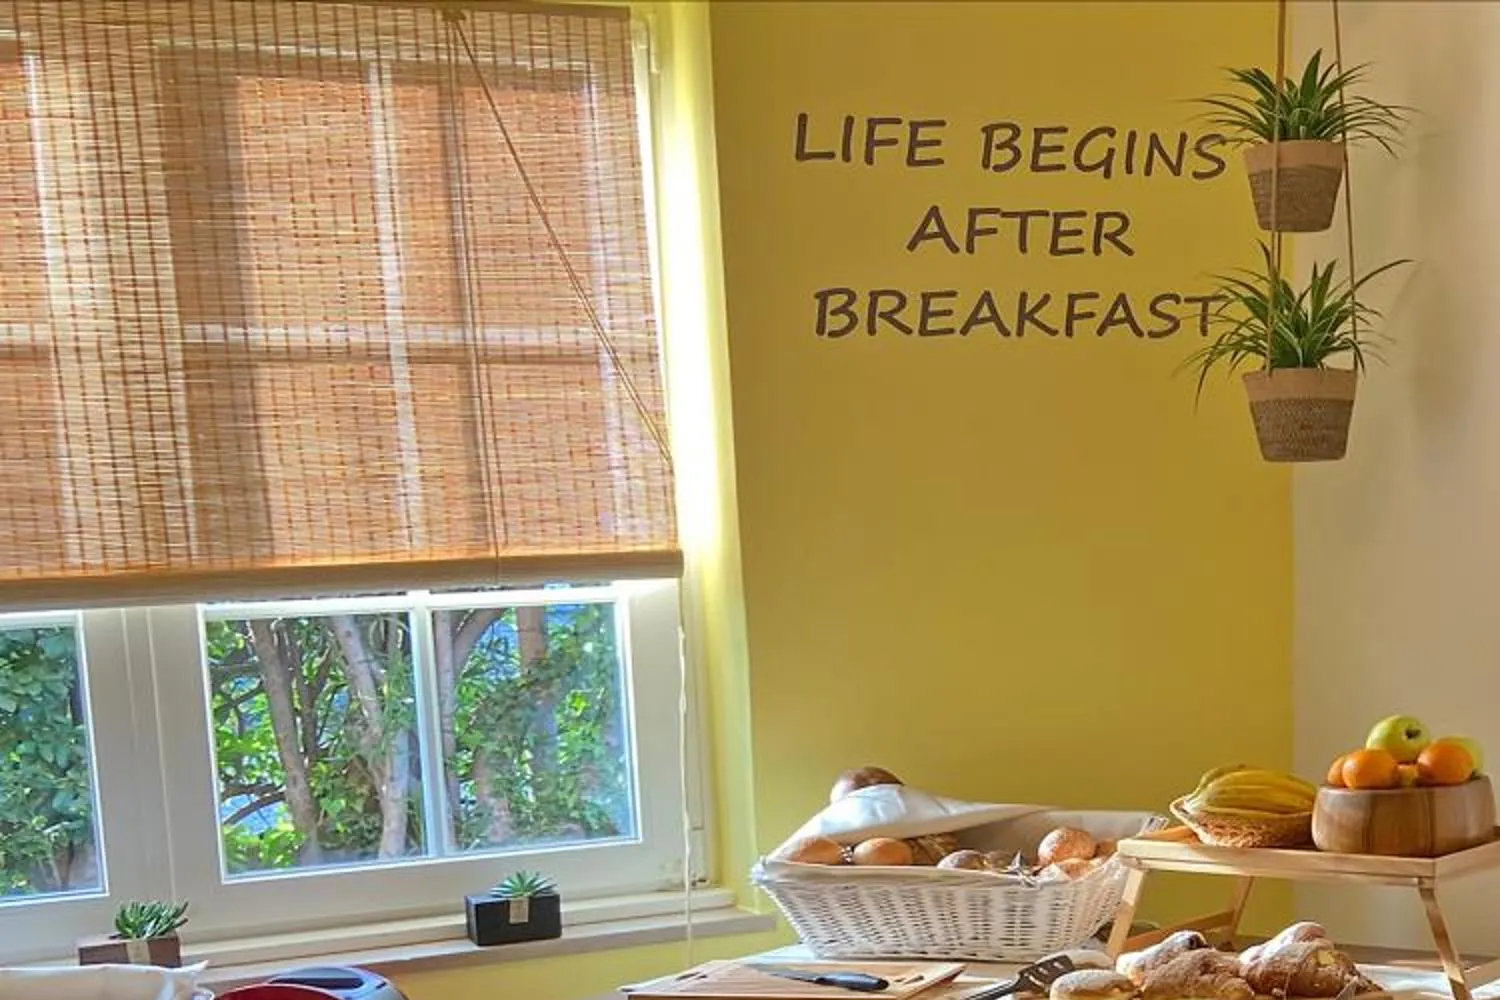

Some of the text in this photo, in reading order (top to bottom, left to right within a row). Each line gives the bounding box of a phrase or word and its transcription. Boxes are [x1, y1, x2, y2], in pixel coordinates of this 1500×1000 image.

[794, 112, 1230, 180] LIFE BEGINS
[906, 204, 1135, 257] AFTER
[813, 286, 1230, 339] BREAKFAST
